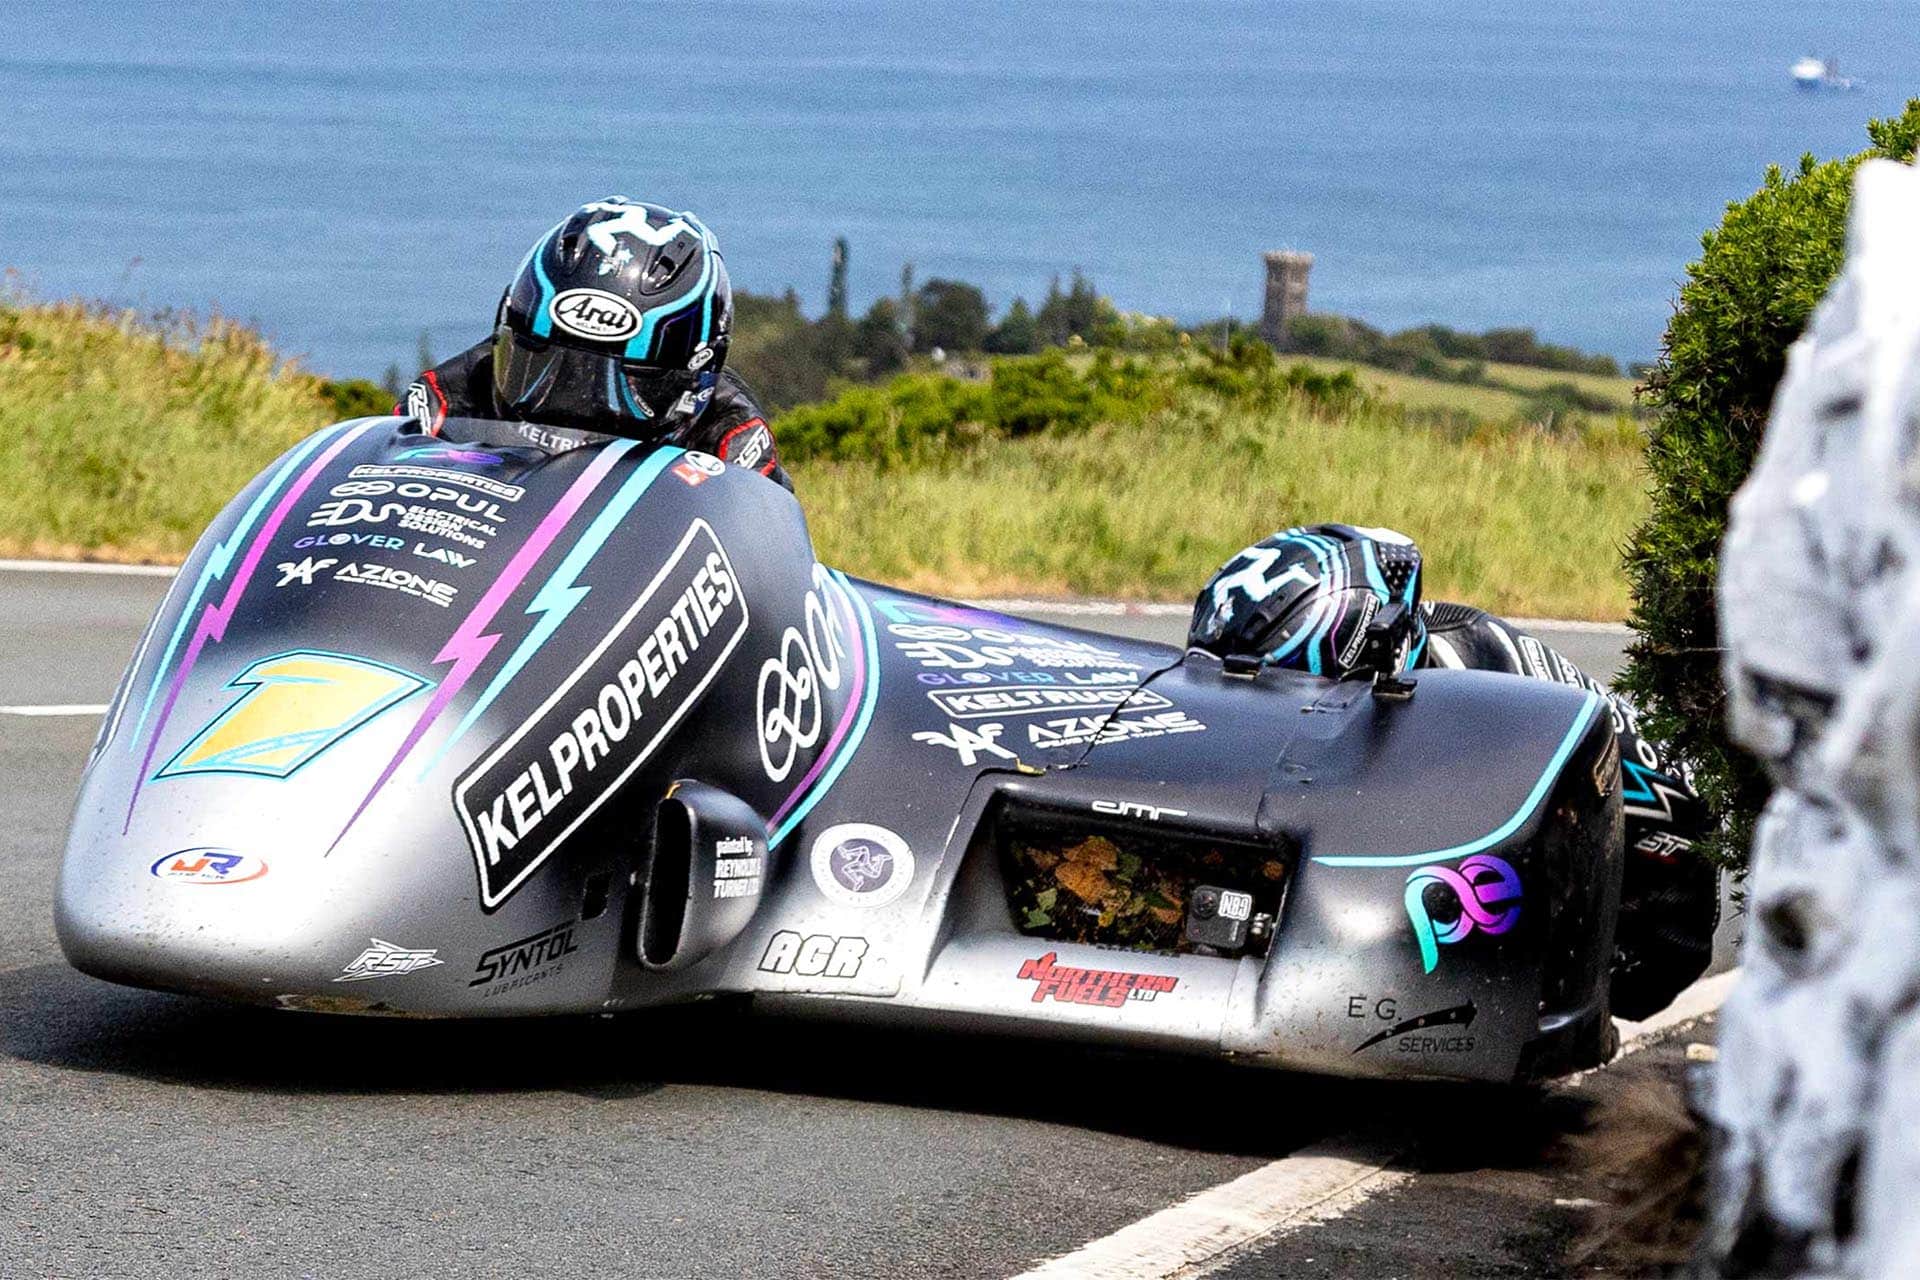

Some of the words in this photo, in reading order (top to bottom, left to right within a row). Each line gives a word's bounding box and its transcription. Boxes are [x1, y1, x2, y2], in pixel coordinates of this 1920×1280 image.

[559, 296, 626, 330] Arai
[397, 483, 507, 522] OPUL
[412, 542, 478, 569] LAW
[476, 551, 735, 866] KELPROPERTIES
[944, 688, 1160, 713] KELTRUCK
[468, 919, 579, 988] SYNTOL
[1398, 1036, 1476, 1054] SERVICES
